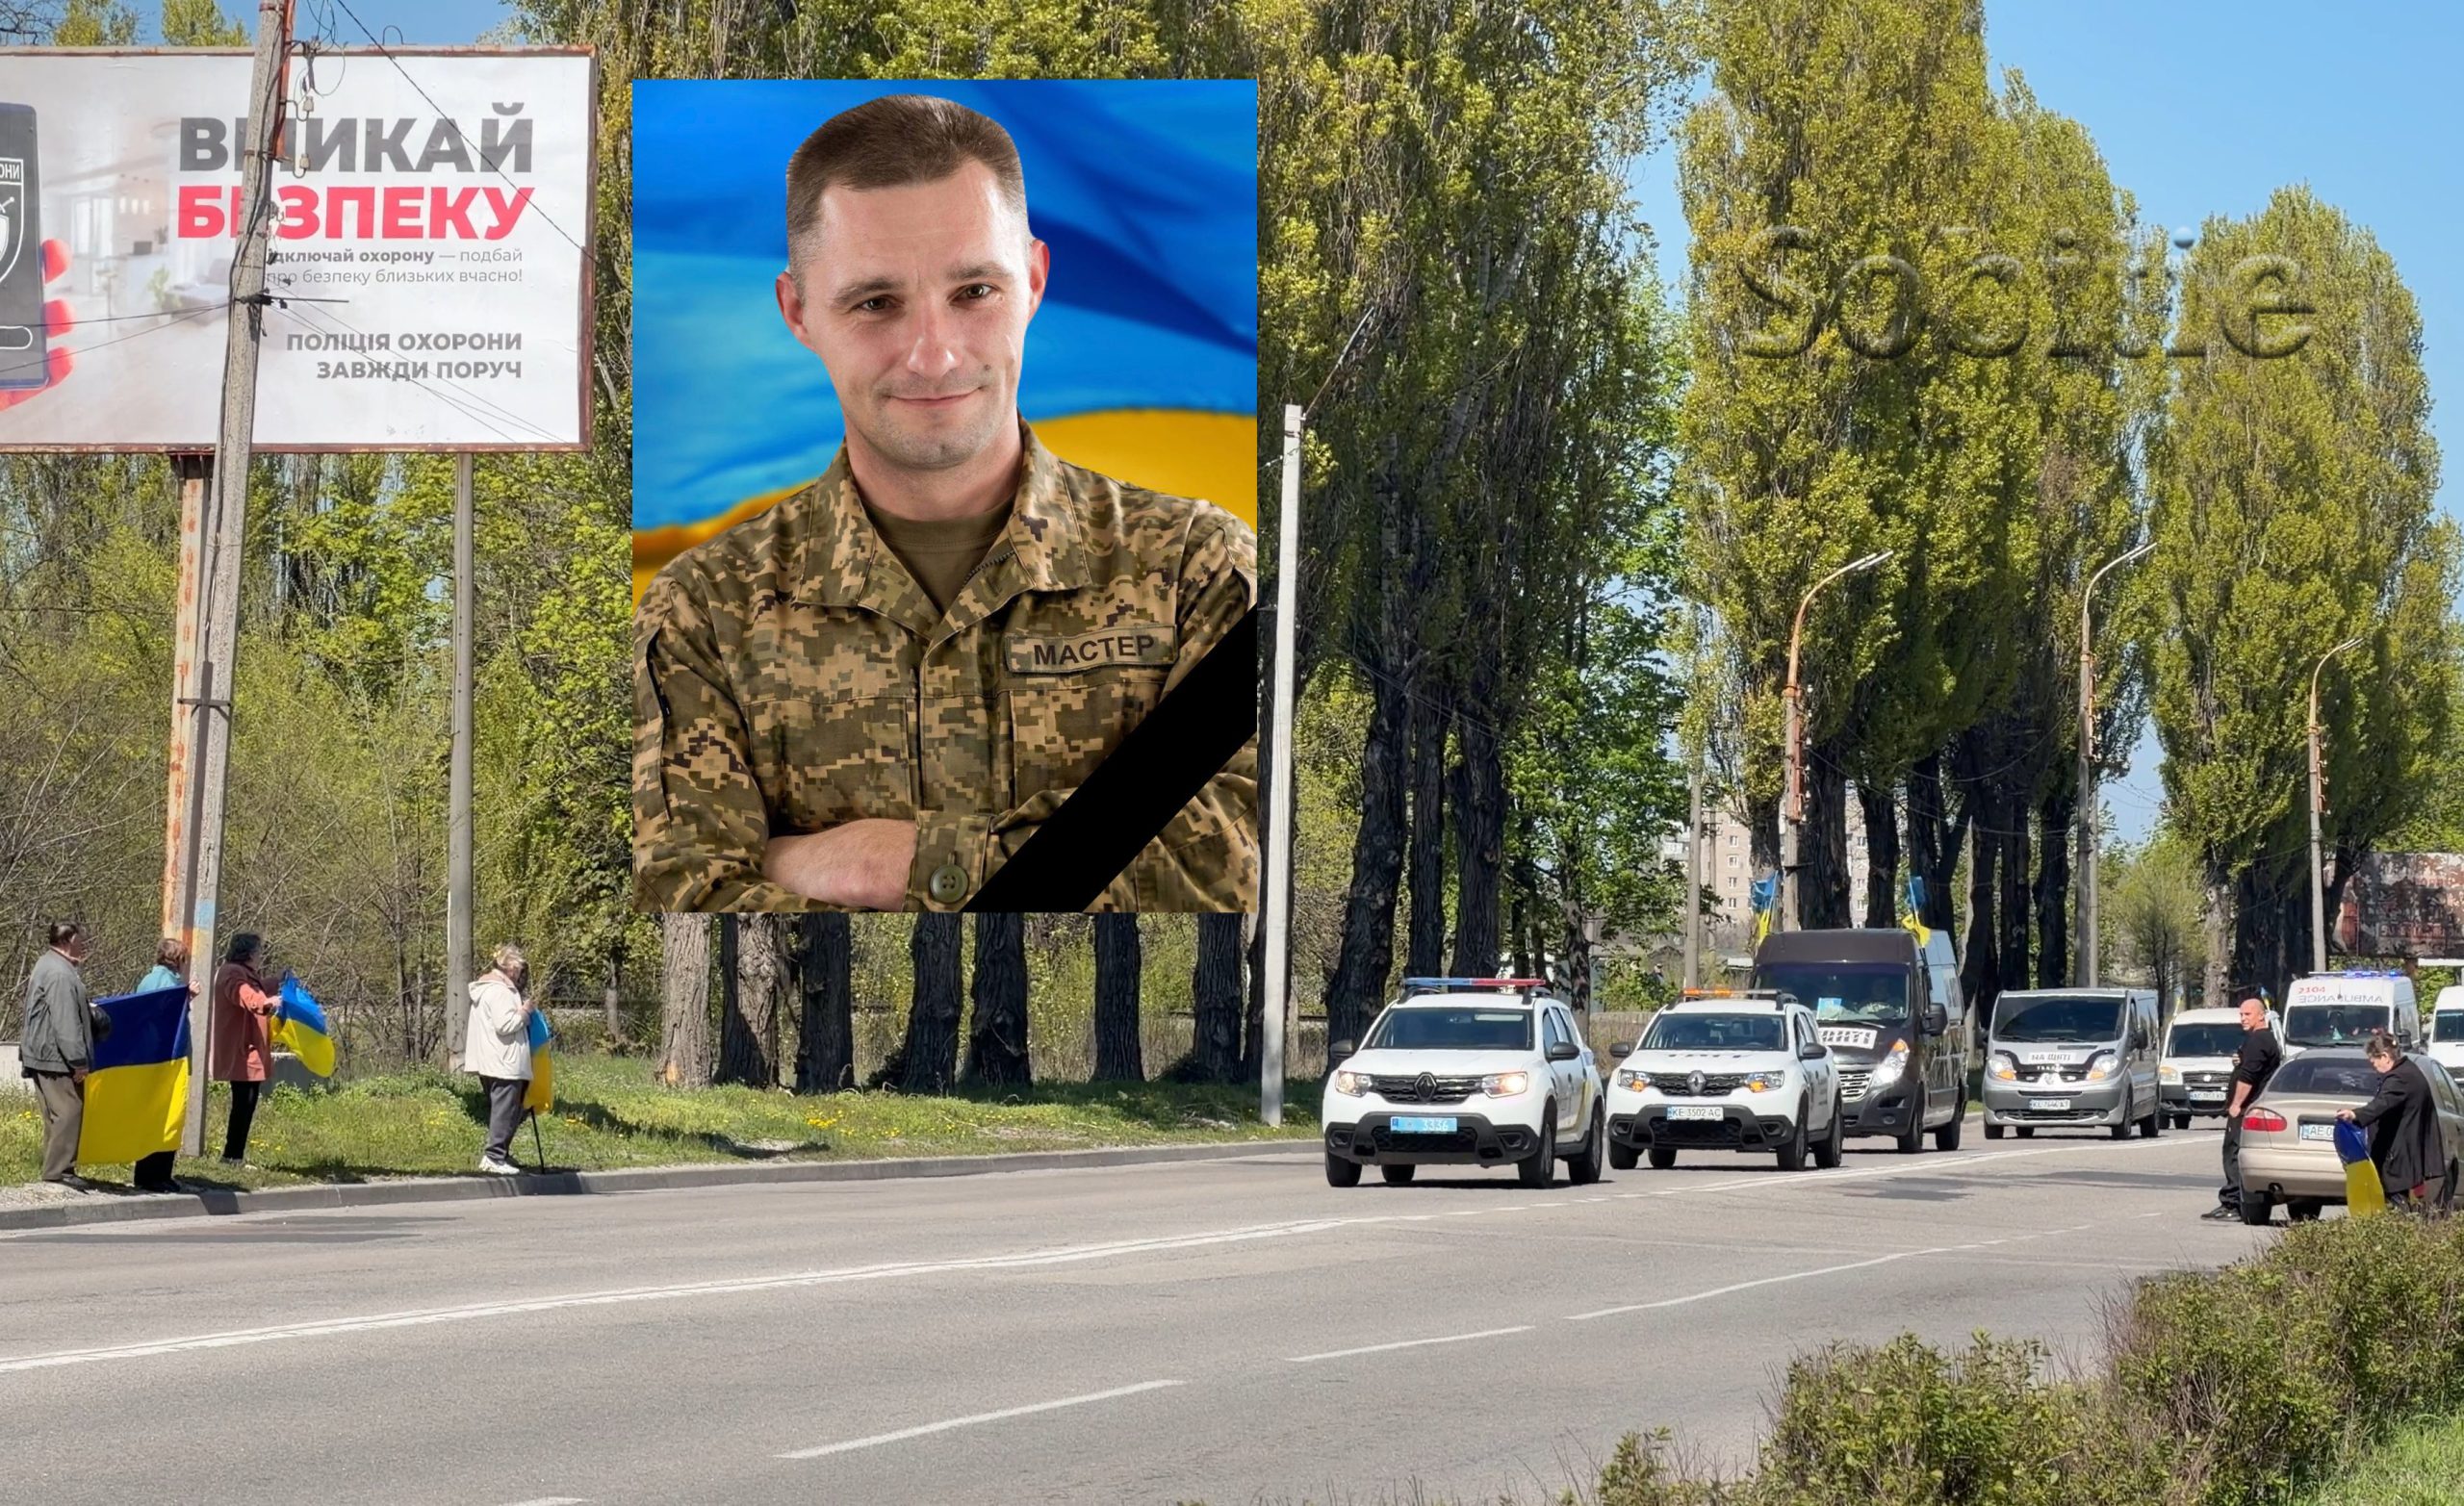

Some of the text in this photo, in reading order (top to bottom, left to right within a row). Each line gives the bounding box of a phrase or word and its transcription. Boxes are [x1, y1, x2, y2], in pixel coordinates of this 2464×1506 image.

[177, 185, 535, 241] БЗПЕКУ
[268, 247, 354, 264] ідключай
[359, 250, 434, 265] охорону
[460, 247, 523, 263] подбай
[267, 268, 523, 287] про безпеку близьких вчасно!
[287, 333, 522, 353] ПОЛІЦІЯ ОХОРОНИ
[316, 361, 522, 381] ЗАВЖДИ ПОРУЧ
[1034, 634, 1155, 665] МАСТЕР
